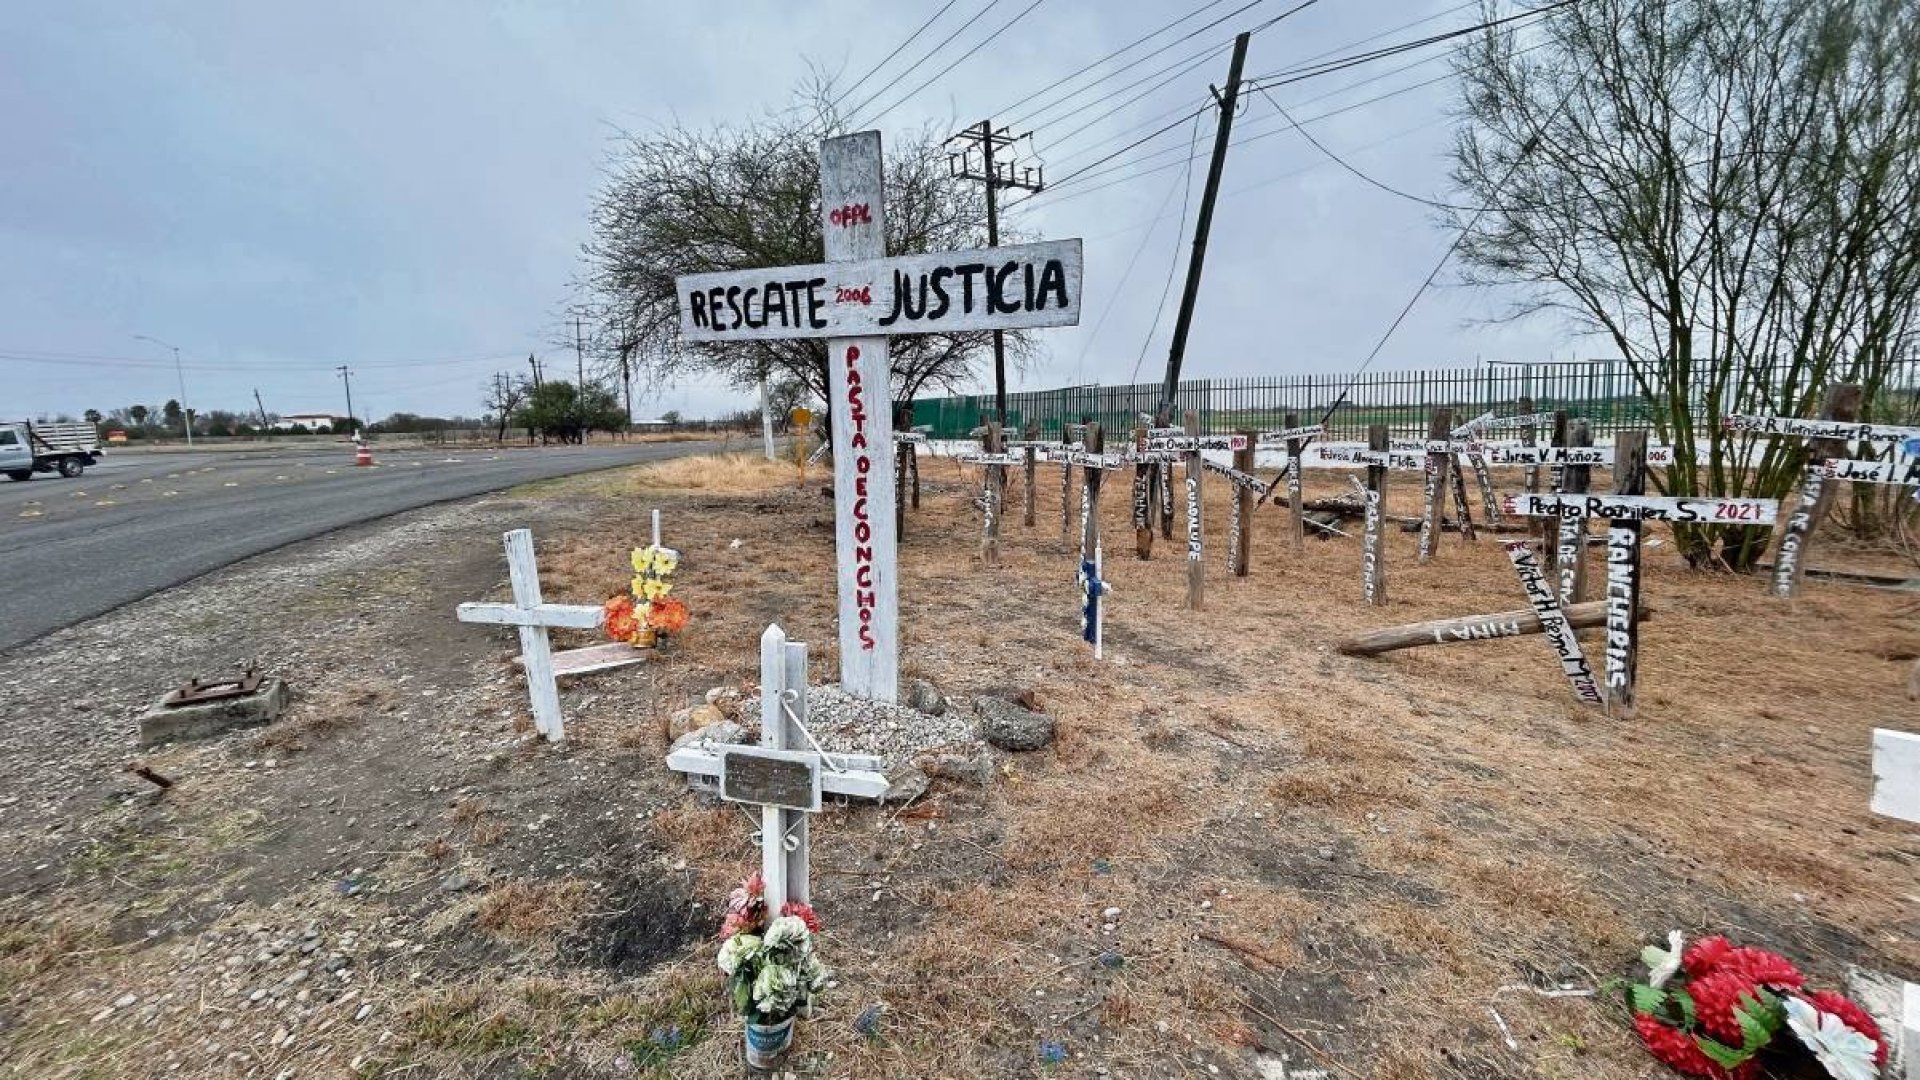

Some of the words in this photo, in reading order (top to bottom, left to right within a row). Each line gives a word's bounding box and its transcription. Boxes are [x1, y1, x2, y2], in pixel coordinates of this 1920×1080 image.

[691, 277, 827, 331] RESCATE
[836, 286, 871, 305] 2006
[879, 260, 1068, 326] JUSTICIA
[1837, 461, 1882, 480] José
[1529, 496, 1582, 519] Pedro
[1676, 501, 1708, 522] S.
[1715, 502, 1761, 520] 2021
